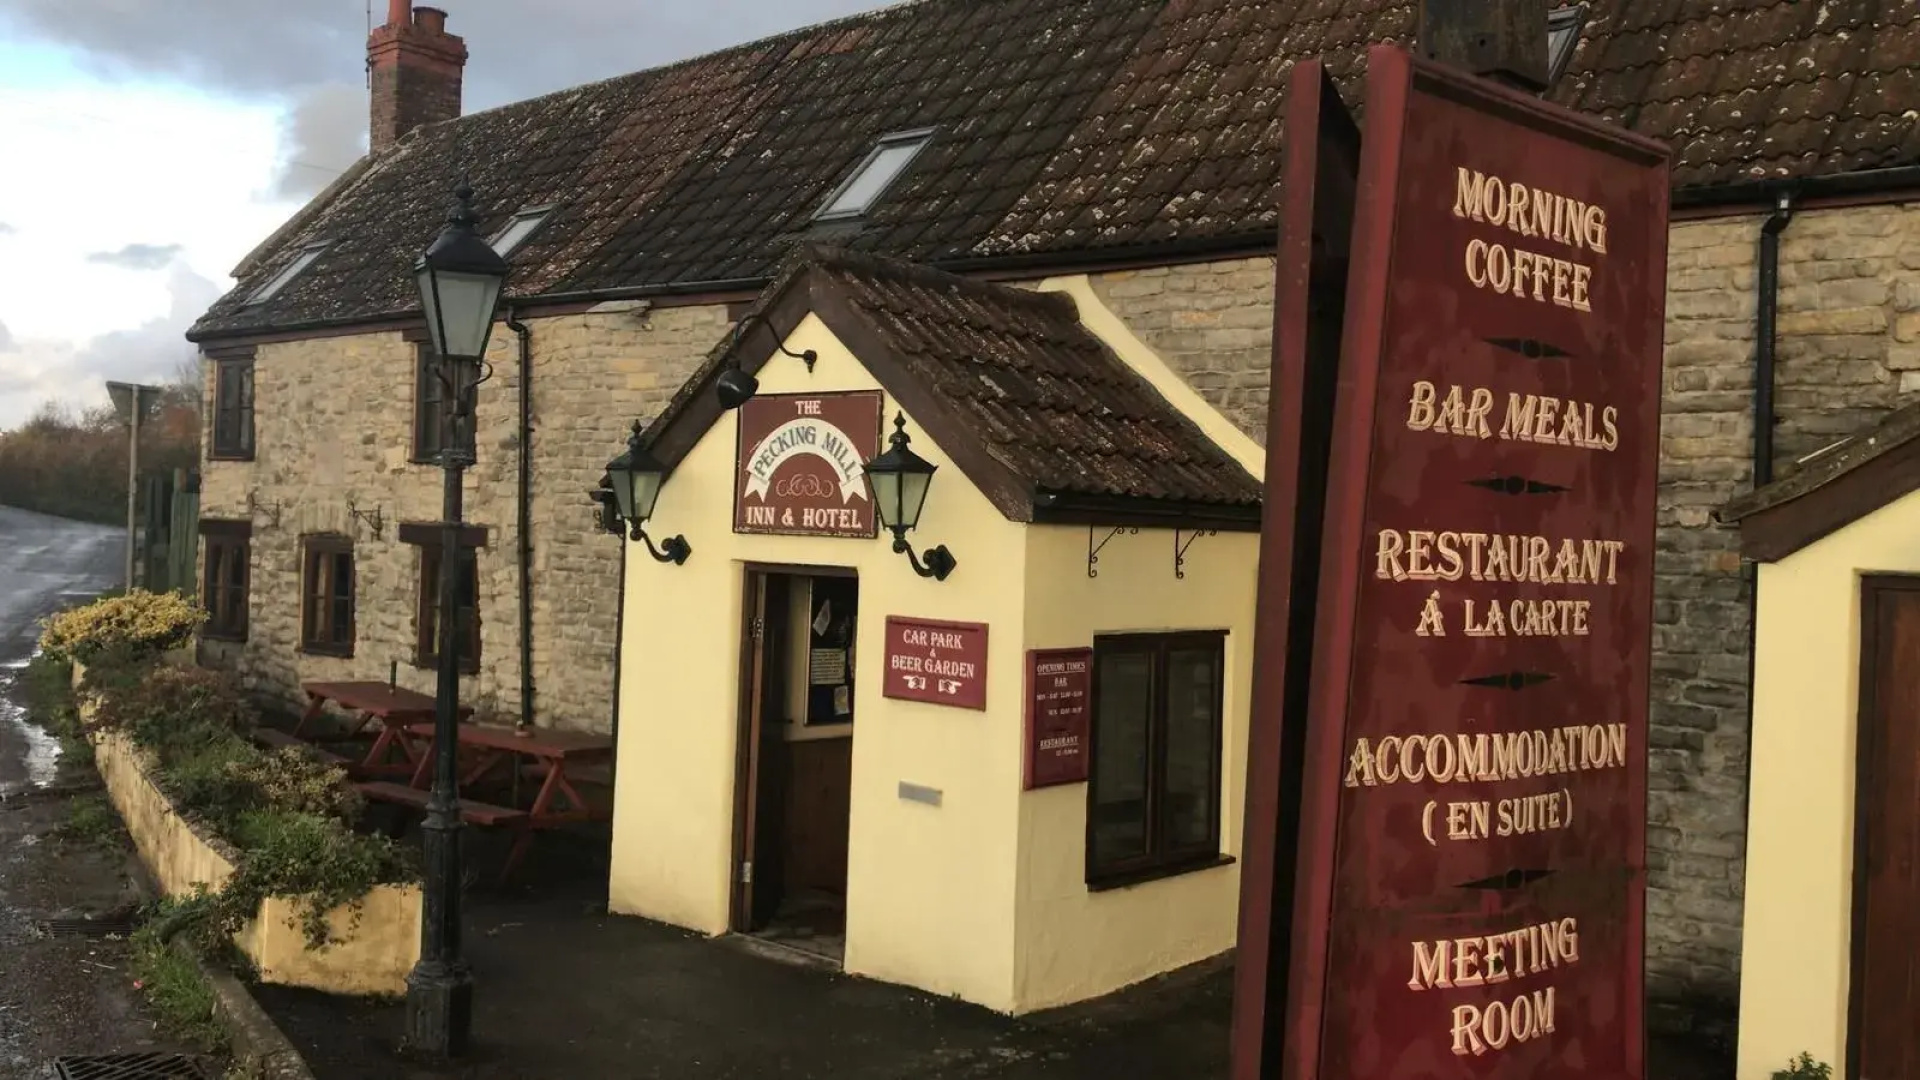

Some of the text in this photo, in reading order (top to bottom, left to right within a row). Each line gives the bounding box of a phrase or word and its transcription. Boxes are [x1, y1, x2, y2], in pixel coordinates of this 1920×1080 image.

[1453, 166, 1607, 254] MORNING
[1465, 238, 1592, 312] COFFEE
[795, 400, 822, 415] THE
[1407, 380, 1619, 451] BAR MEALS
[754, 425, 857, 481] PECKING MILL
[746, 506, 862, 528] INN & HOTEL
[1376, 528, 1625, 586] RESTAURANT
[903, 629, 963, 650] CAR PARK
[1463, 599, 1506, 637] LA
[1510, 599, 1591, 637] CARTE
[891, 654, 975, 679] BEER GARDEN
[929, 648, 937, 658] &
[1037, 662, 1086, 674] OPENING TIMES
[1039, 735, 1079, 750] RESTAURANT
[1345, 724, 1626, 787] ACCOMMODATION
[1407, 917, 1579, 991] MEETING
[1450, 986, 1555, 1056] ROOM
